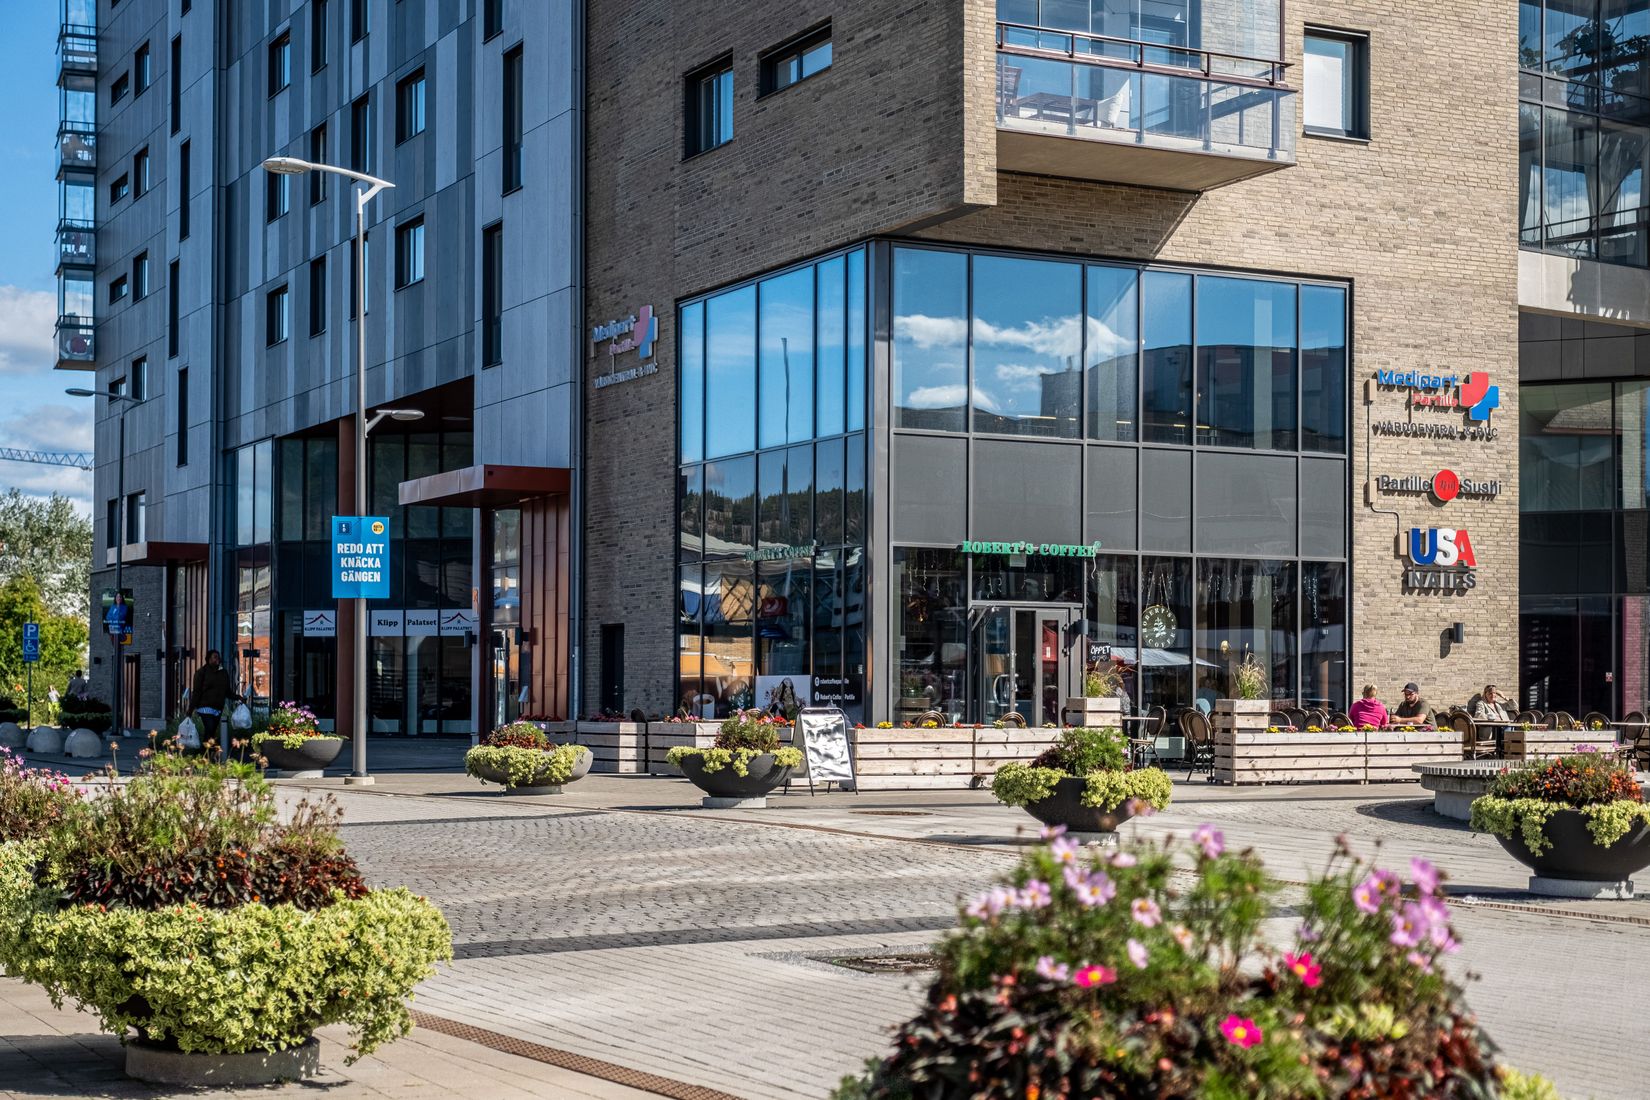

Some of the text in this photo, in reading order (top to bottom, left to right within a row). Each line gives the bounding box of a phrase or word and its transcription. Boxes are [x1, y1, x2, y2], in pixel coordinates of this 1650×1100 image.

[1378, 368, 1458, 390] Medipart
[1380, 475, 1431, 491] Partille
[1462, 478, 1502, 495] Sushi
[337, 543, 385, 554] REDO ATT
[962, 540, 1098, 558] ROBERT'S COFFEE
[1408, 527, 1477, 567] USA
[340, 556, 382, 568] KNÄCKA
[341, 569, 382, 583] GÄNGEN
[1408, 571, 1477, 589] NAILS
[27, 624, 37, 637] P
[377, 619, 399, 627] Klipp
